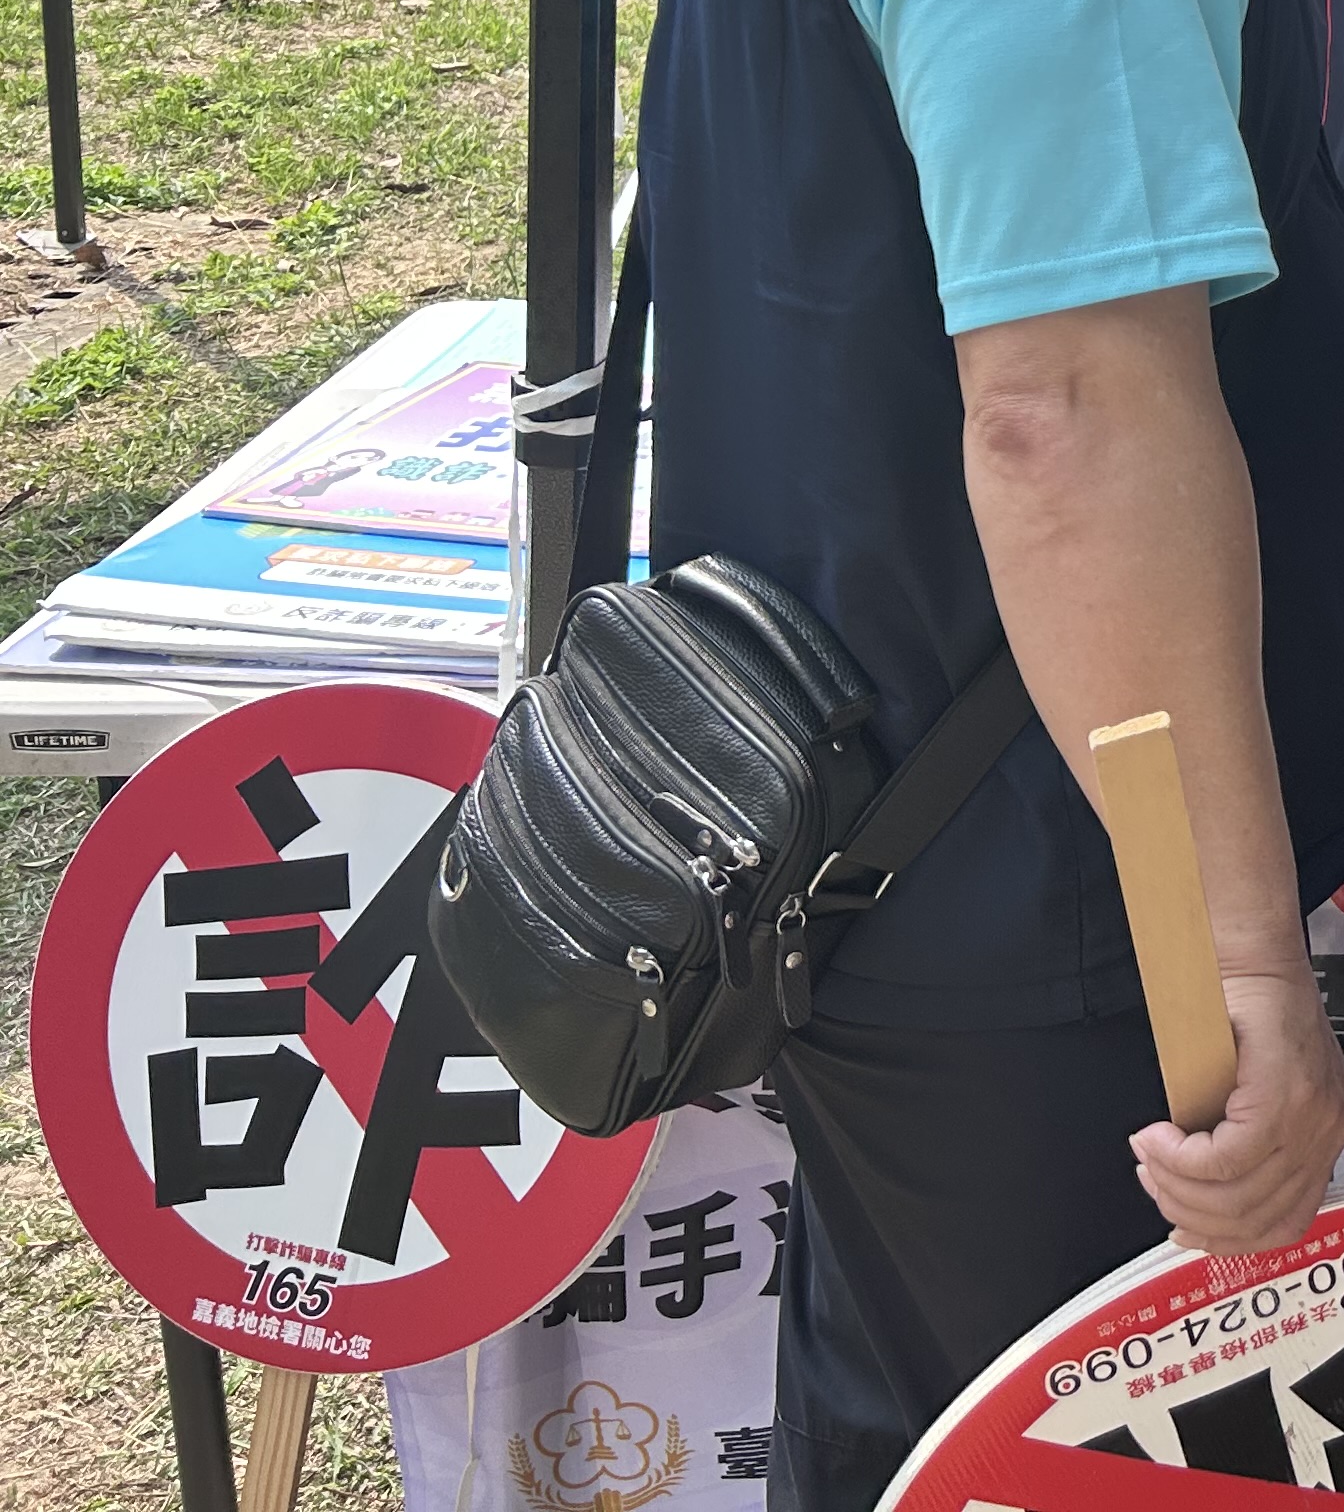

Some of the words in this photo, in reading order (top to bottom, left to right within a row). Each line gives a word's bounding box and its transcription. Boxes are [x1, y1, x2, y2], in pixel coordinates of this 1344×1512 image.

[23, 734, 98, 747] LIFETIME
[147, 756, 521, 1265] 詐
[246, 1232, 348, 1271] 打擊詐騙專線
[243, 1259, 339, 1320] 165
[192, 1297, 372, 1360] 嘉義地檢署關心您
[1126, 1298, 1338, 1399] 法務部檢舉專線
